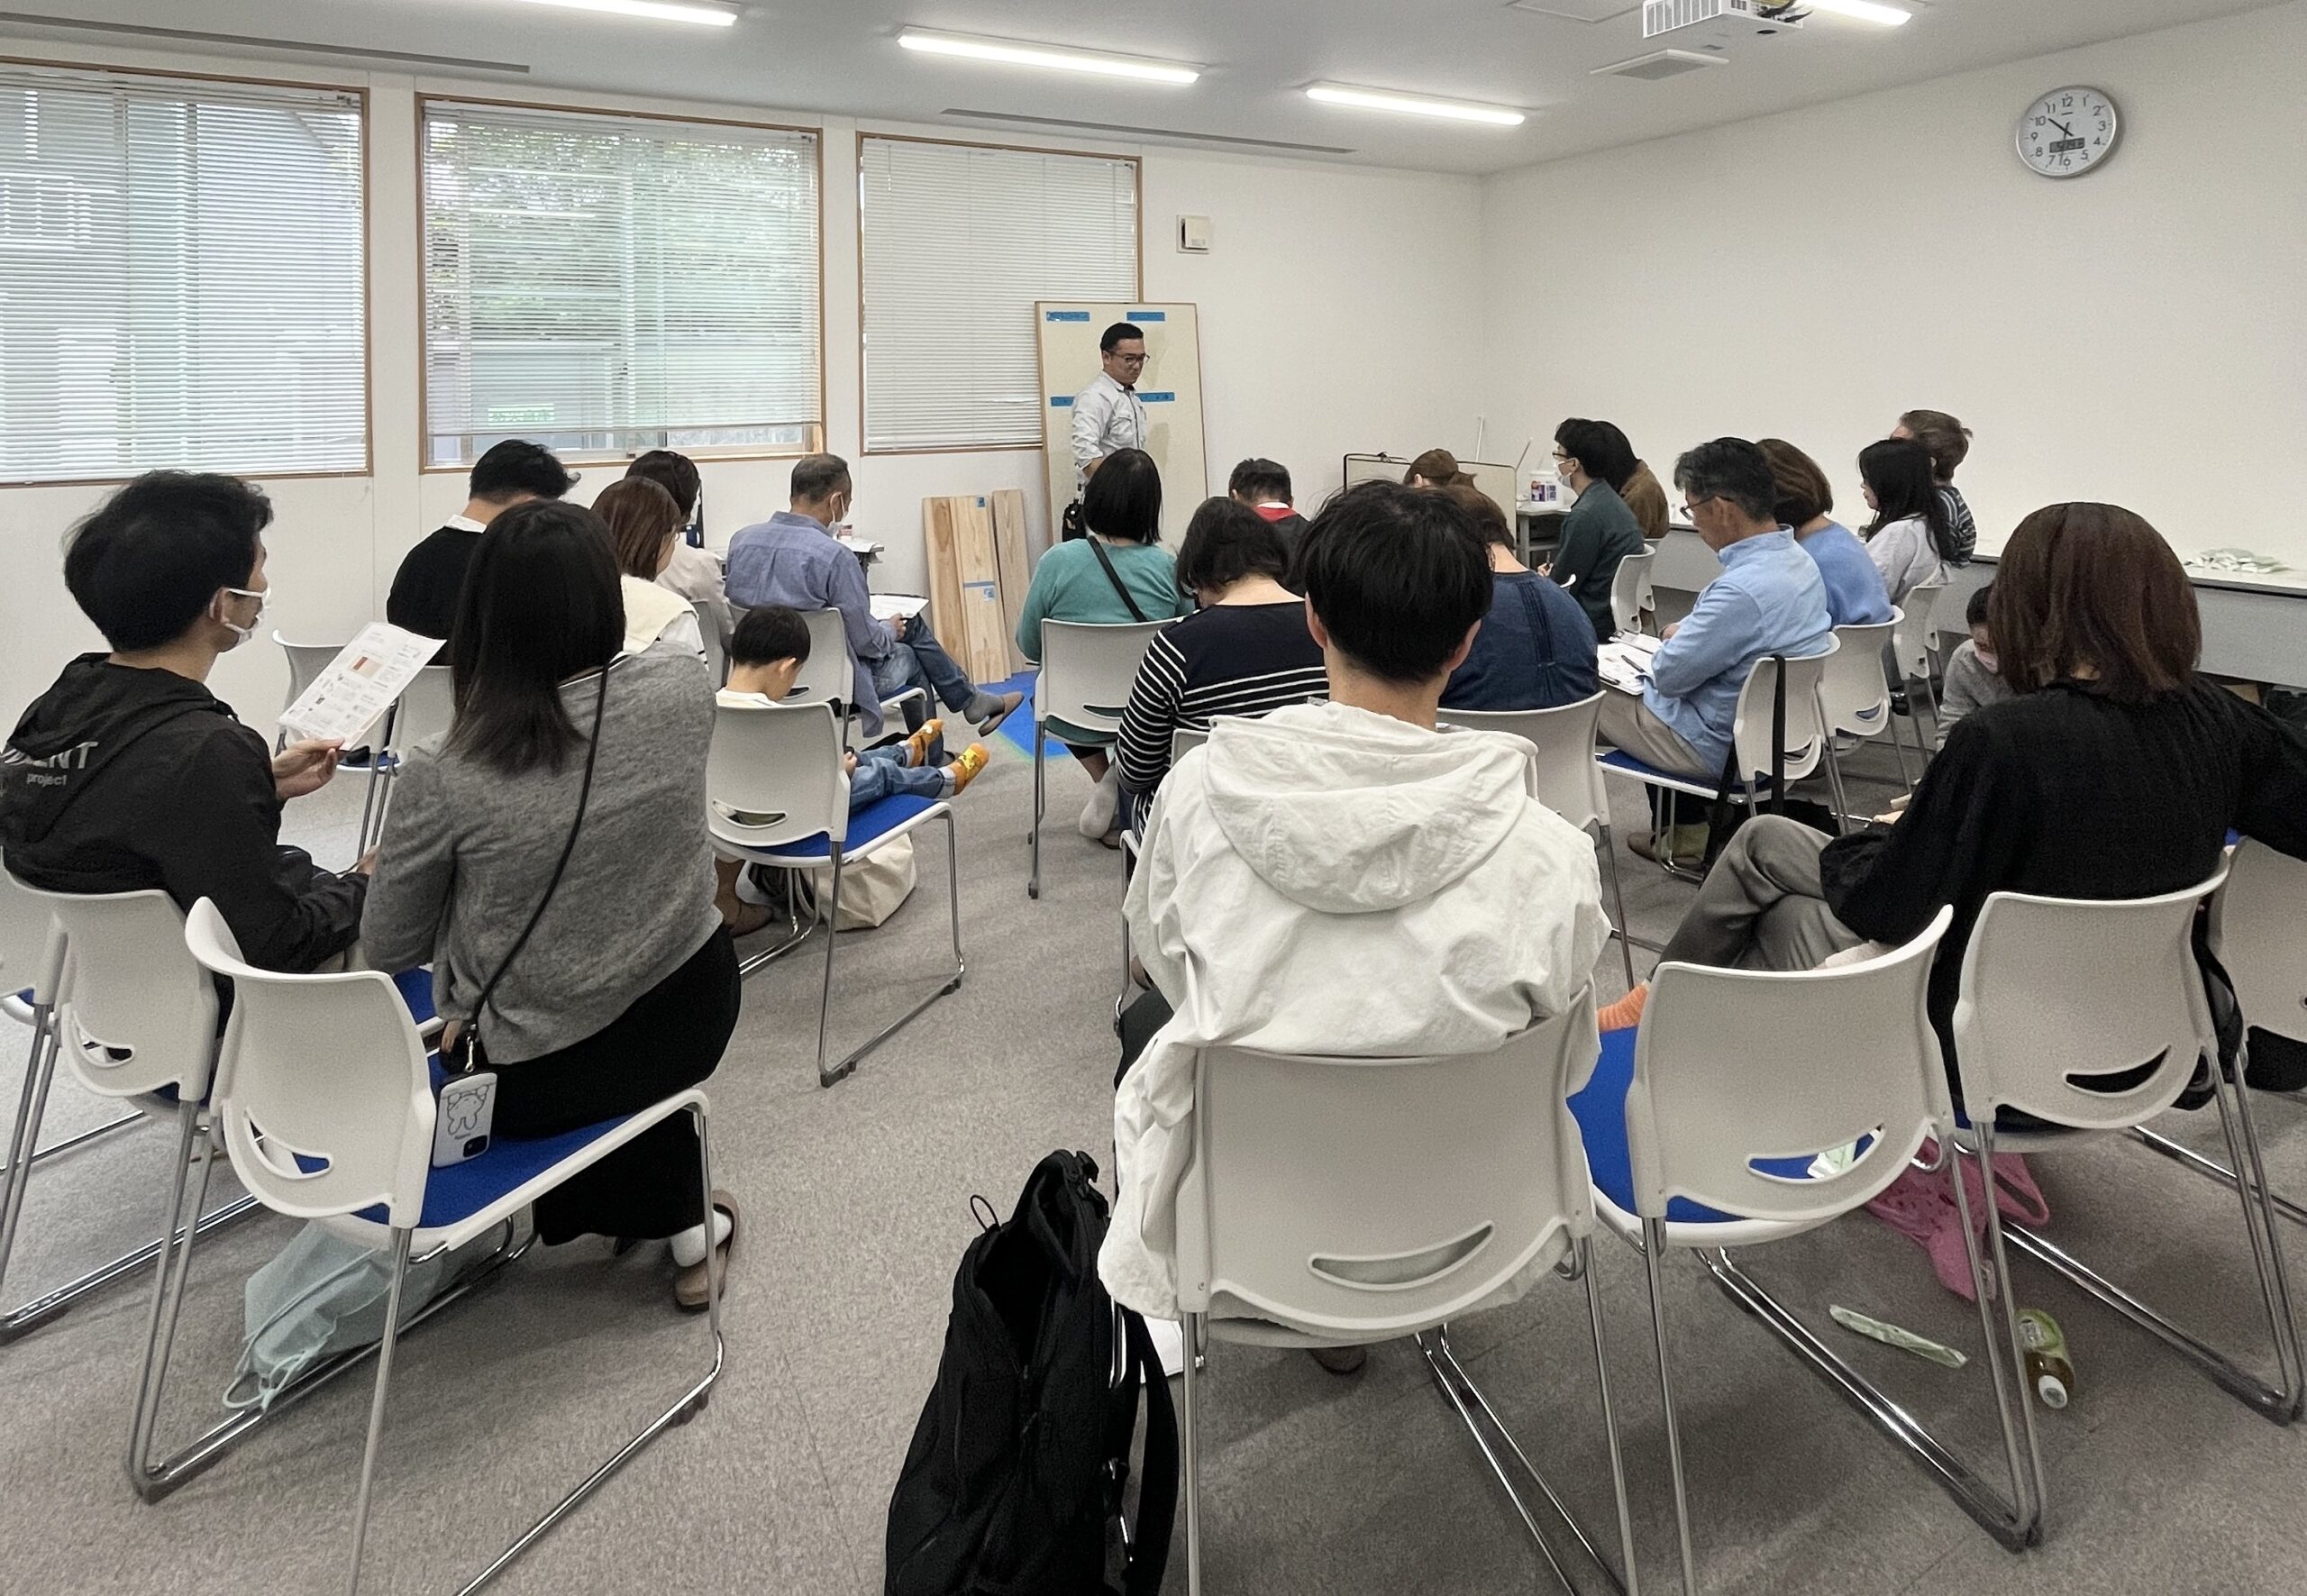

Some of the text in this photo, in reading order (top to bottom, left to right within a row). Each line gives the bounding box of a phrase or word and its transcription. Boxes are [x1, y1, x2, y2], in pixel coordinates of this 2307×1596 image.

[2062, 96, 2074, 107] 12
[2046, 103, 2056, 114] 11
[2093, 105, 2102, 116] 2
[2035, 115, 2047, 127] 10
[2098, 120, 2107, 132] 3
[2030, 132, 2038, 141] 9
[2093, 137, 2101, 146] 4
[2035, 146, 2044, 158] 8
[2081, 149, 2089, 160] 5
[2049, 155, 2056, 166] 7
[2063, 156, 2071, 167] 6
[26, 773, 68, 788] project
